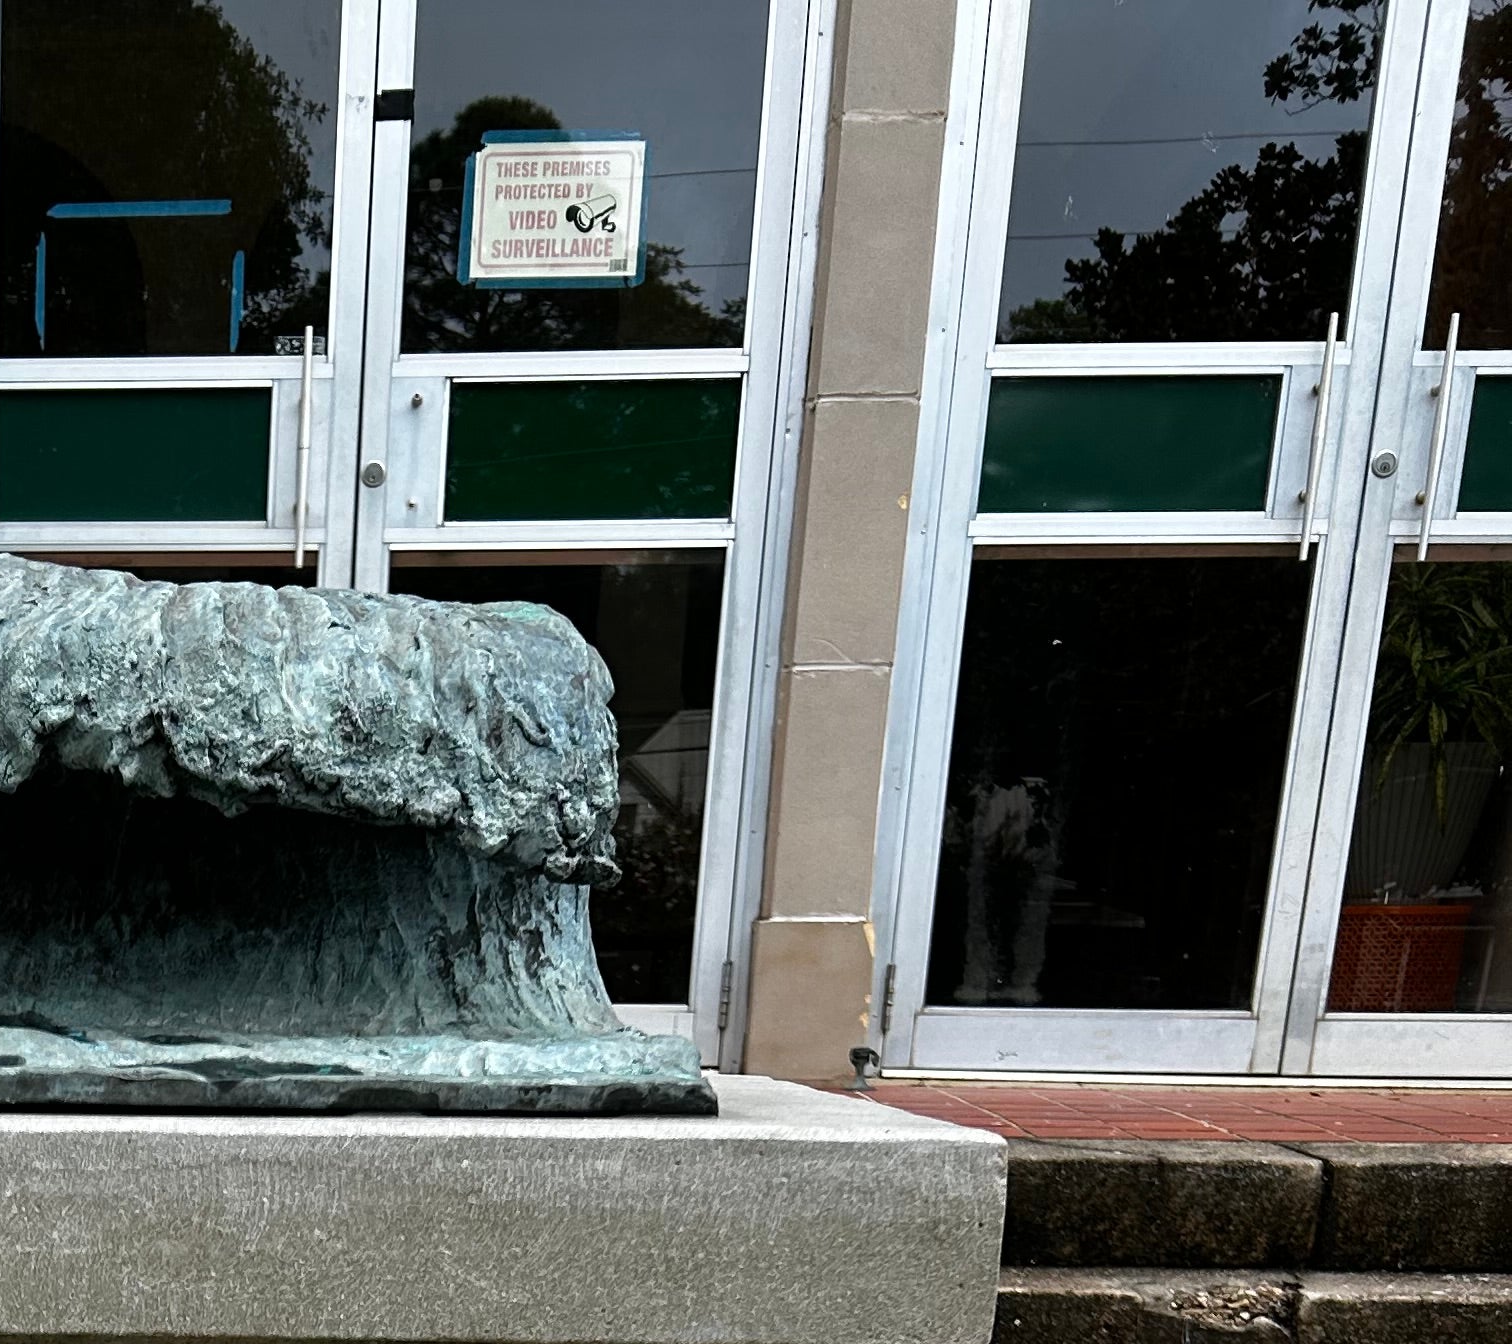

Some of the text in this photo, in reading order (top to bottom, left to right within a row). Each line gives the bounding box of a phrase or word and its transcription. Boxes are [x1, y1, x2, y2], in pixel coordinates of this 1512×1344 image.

[497, 161, 611, 177] THESE PREMISES
[495, 184, 594, 200] PROTECTED BY
[509, 210, 557, 230] VIDEO
[491, 238, 613, 258] SURVEILLANCE
